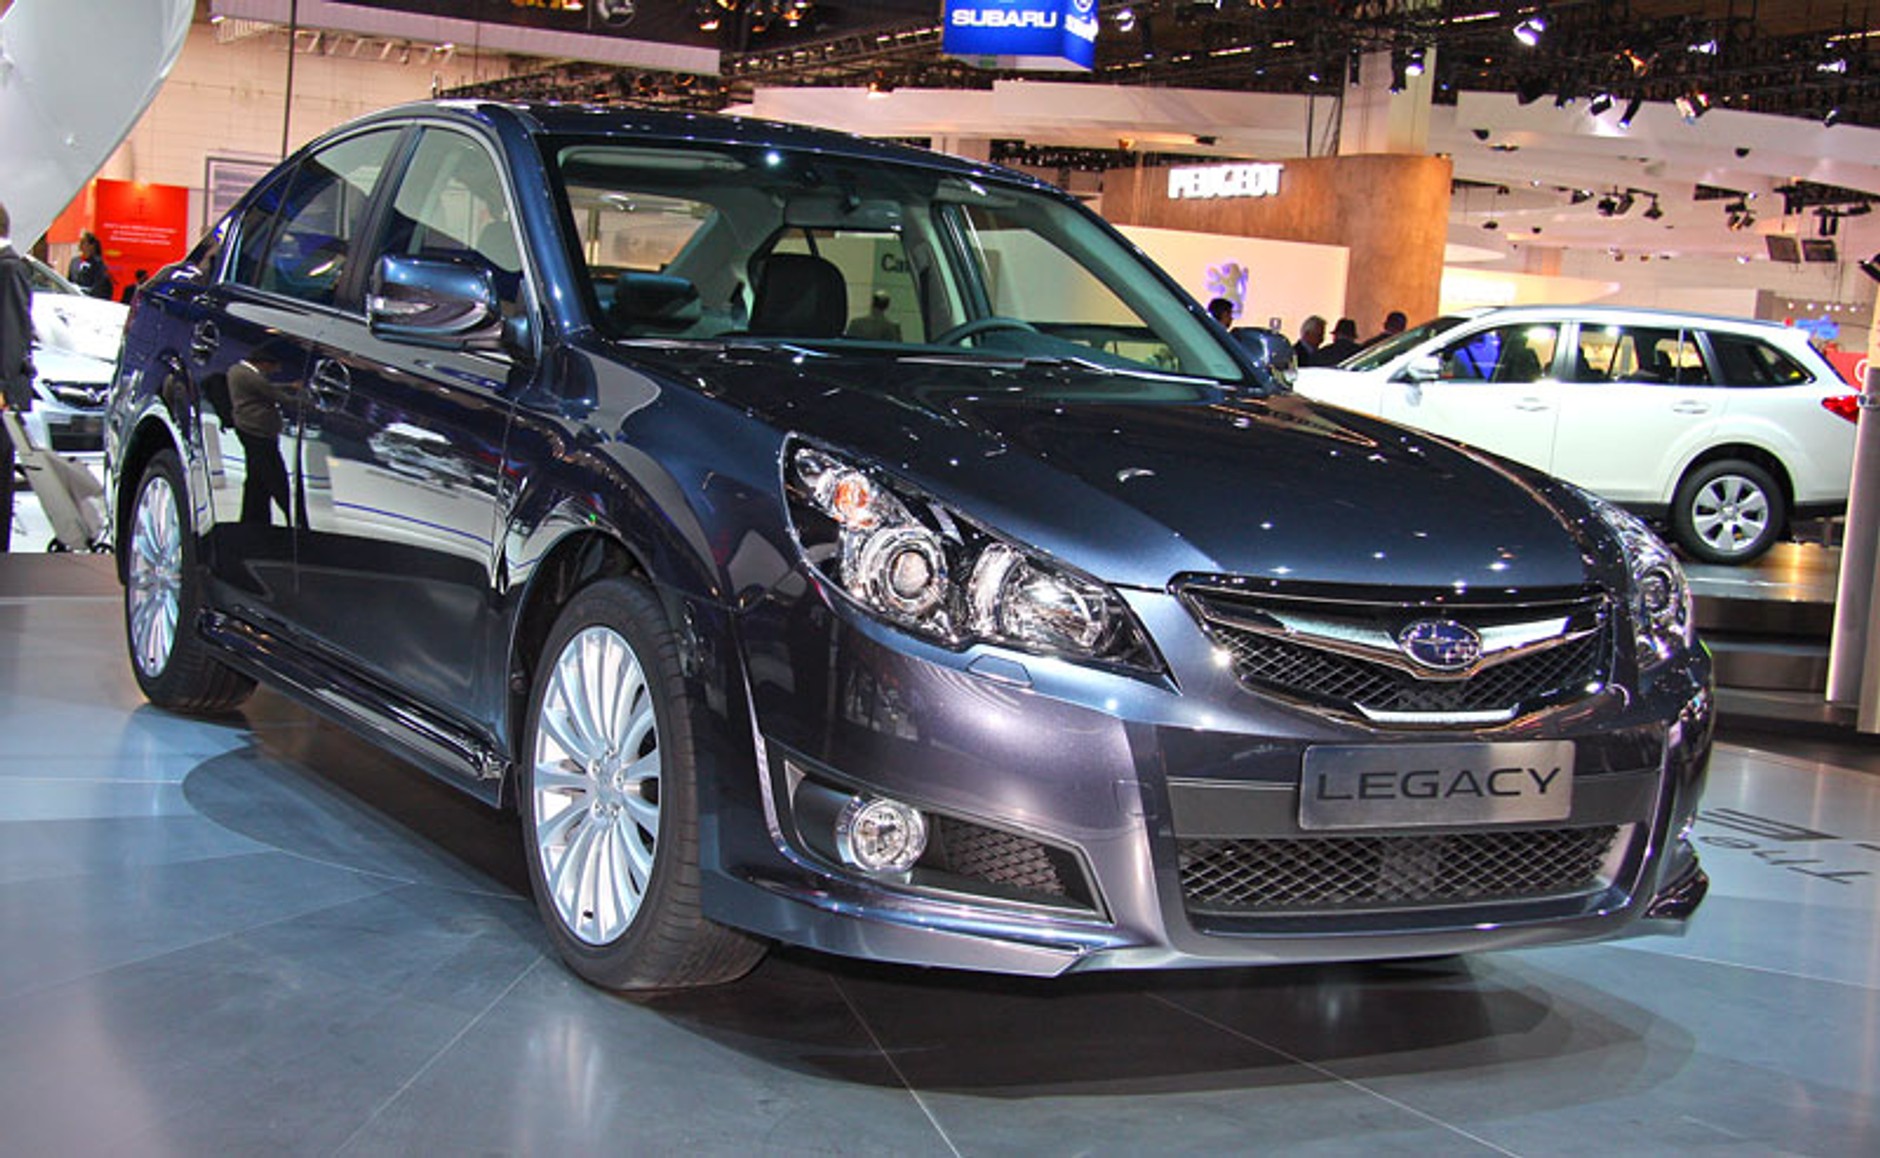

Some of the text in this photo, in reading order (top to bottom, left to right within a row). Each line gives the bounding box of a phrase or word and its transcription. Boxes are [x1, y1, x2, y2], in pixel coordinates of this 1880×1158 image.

[952, 9, 1057, 27] SUBARU
[1168, 163, 1284, 198] PEUGEOT
[1316, 767, 1561, 801] LEGACY
